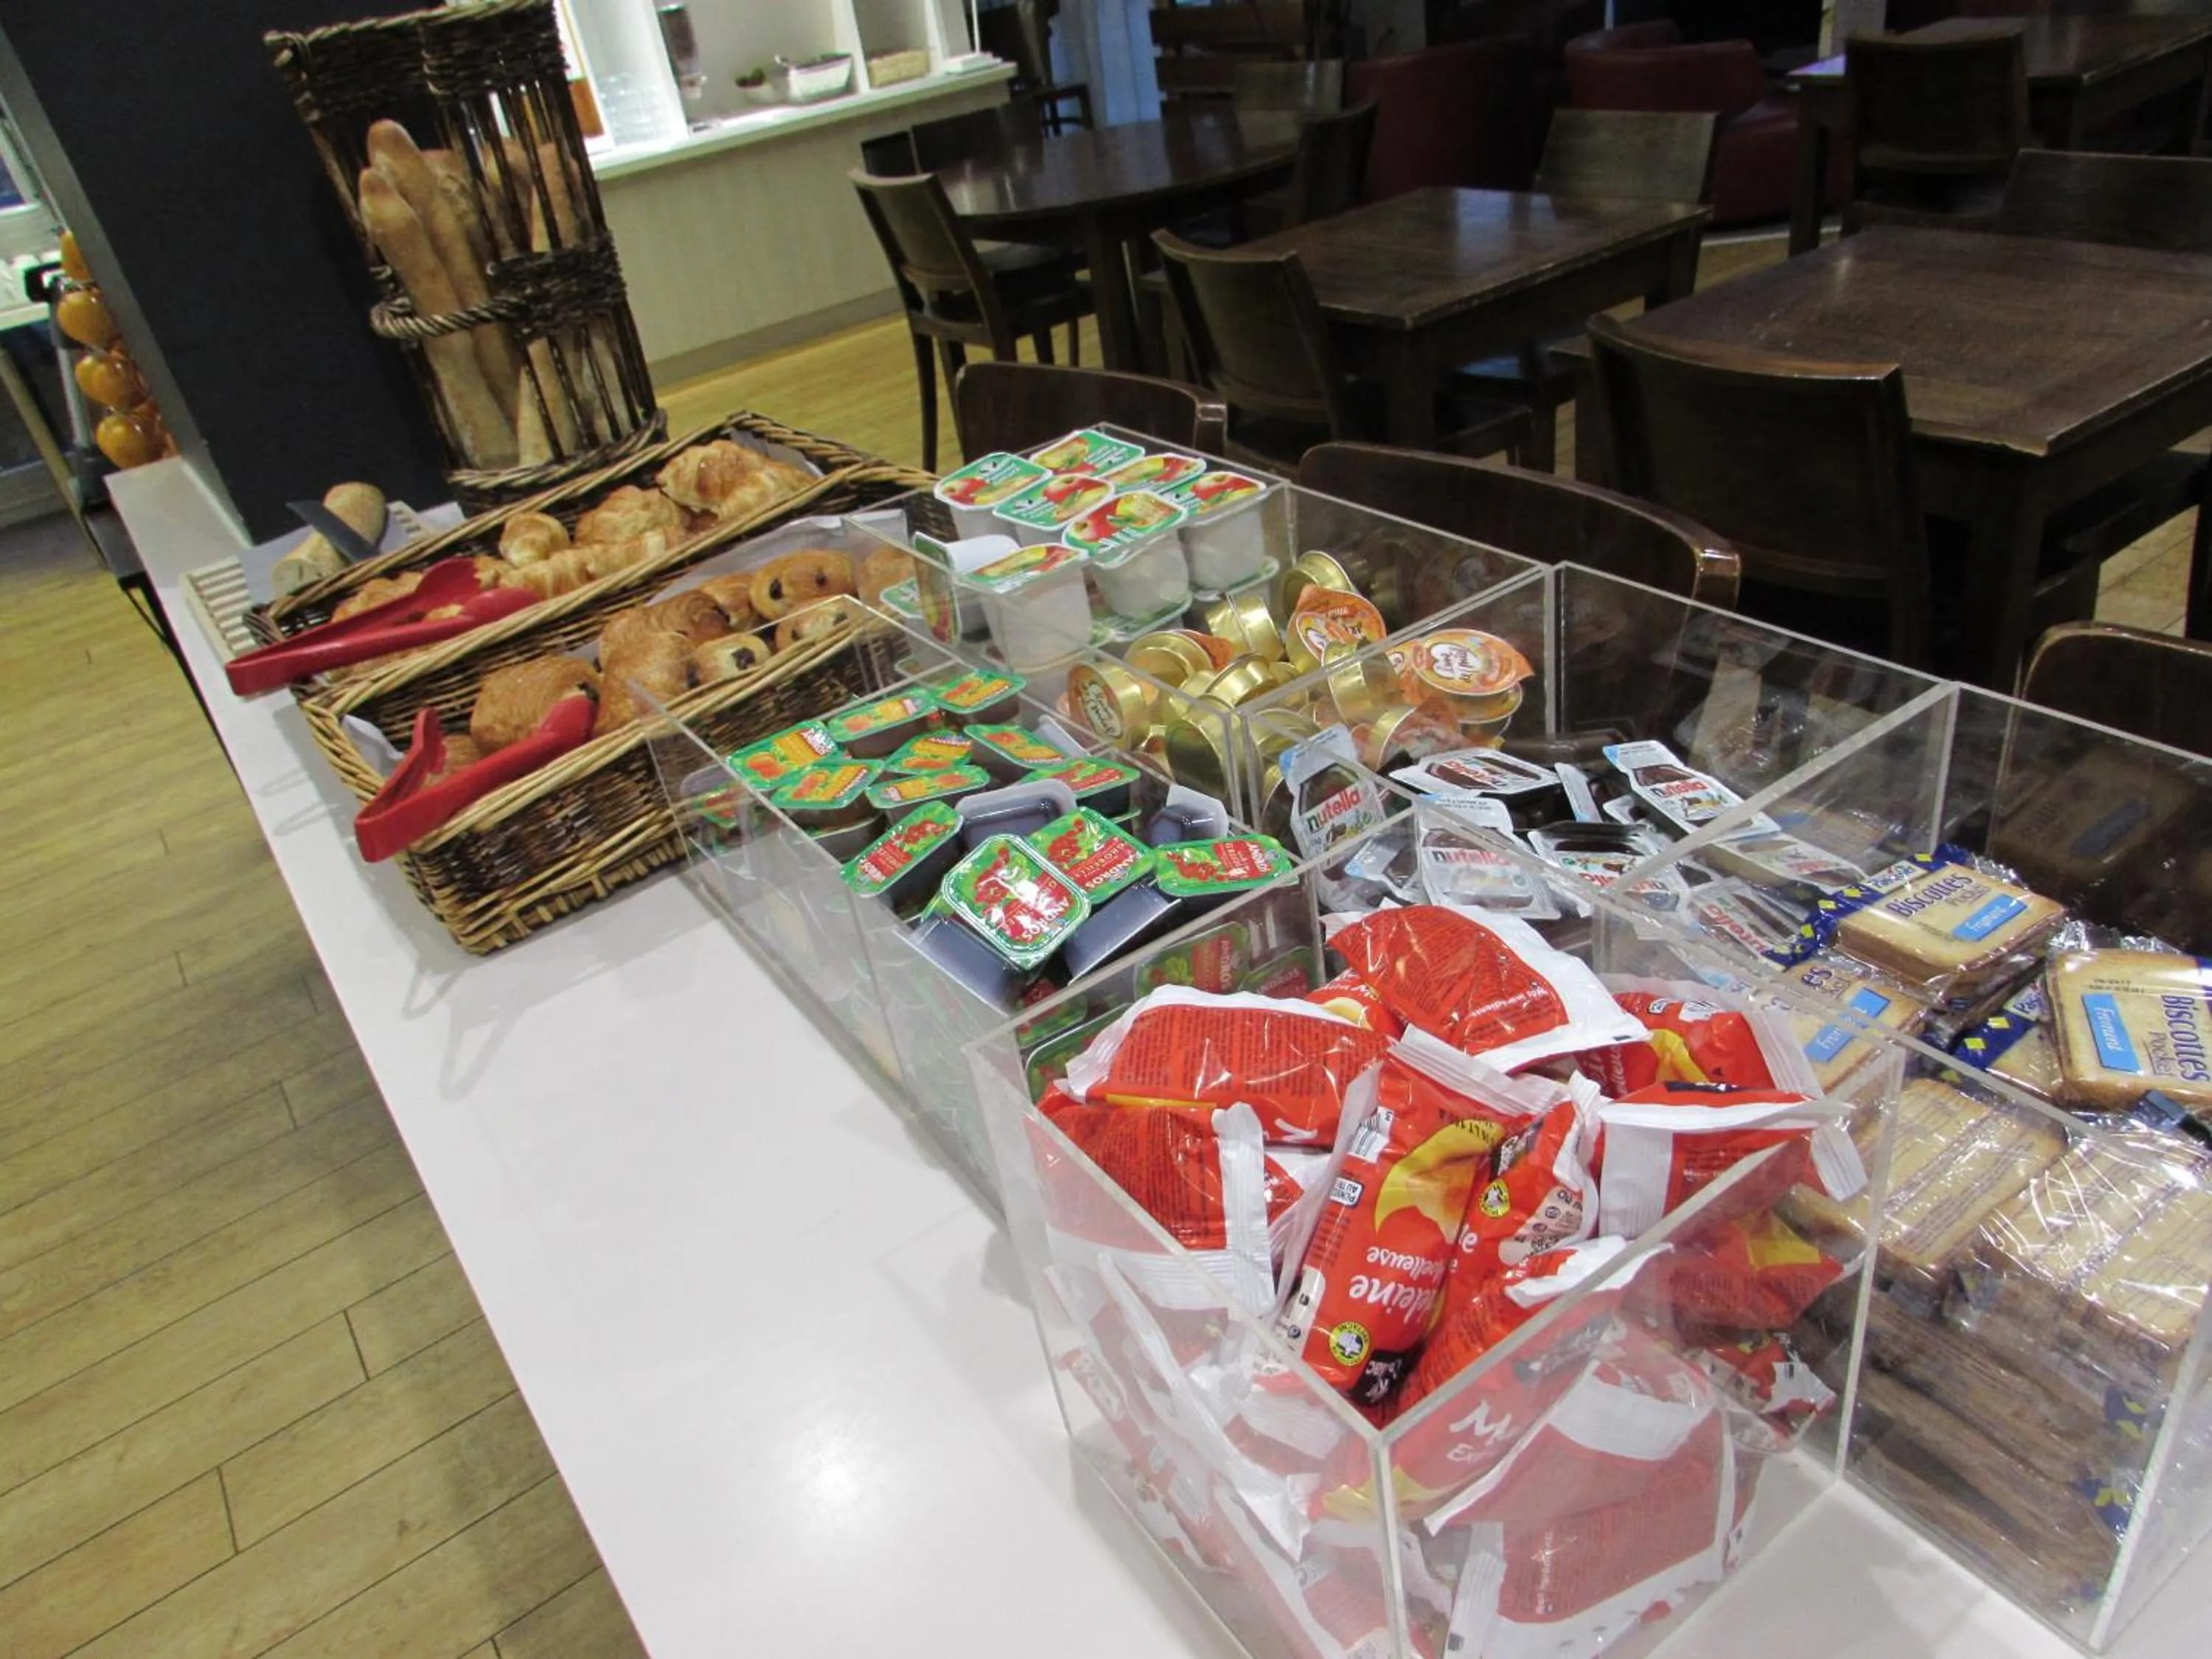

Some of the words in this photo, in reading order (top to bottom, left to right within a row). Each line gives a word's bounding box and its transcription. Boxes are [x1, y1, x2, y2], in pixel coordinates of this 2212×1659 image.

[1307, 789, 1361, 832] nutella
[1650, 780, 1709, 799] nutella
[1886, 872, 1973, 918] Biscottes
[2095, 1007, 2124, 1051] froment
[2160, 994, 2211, 1082] Biscottes
[2149, 1031, 2176, 1077] Pocket
